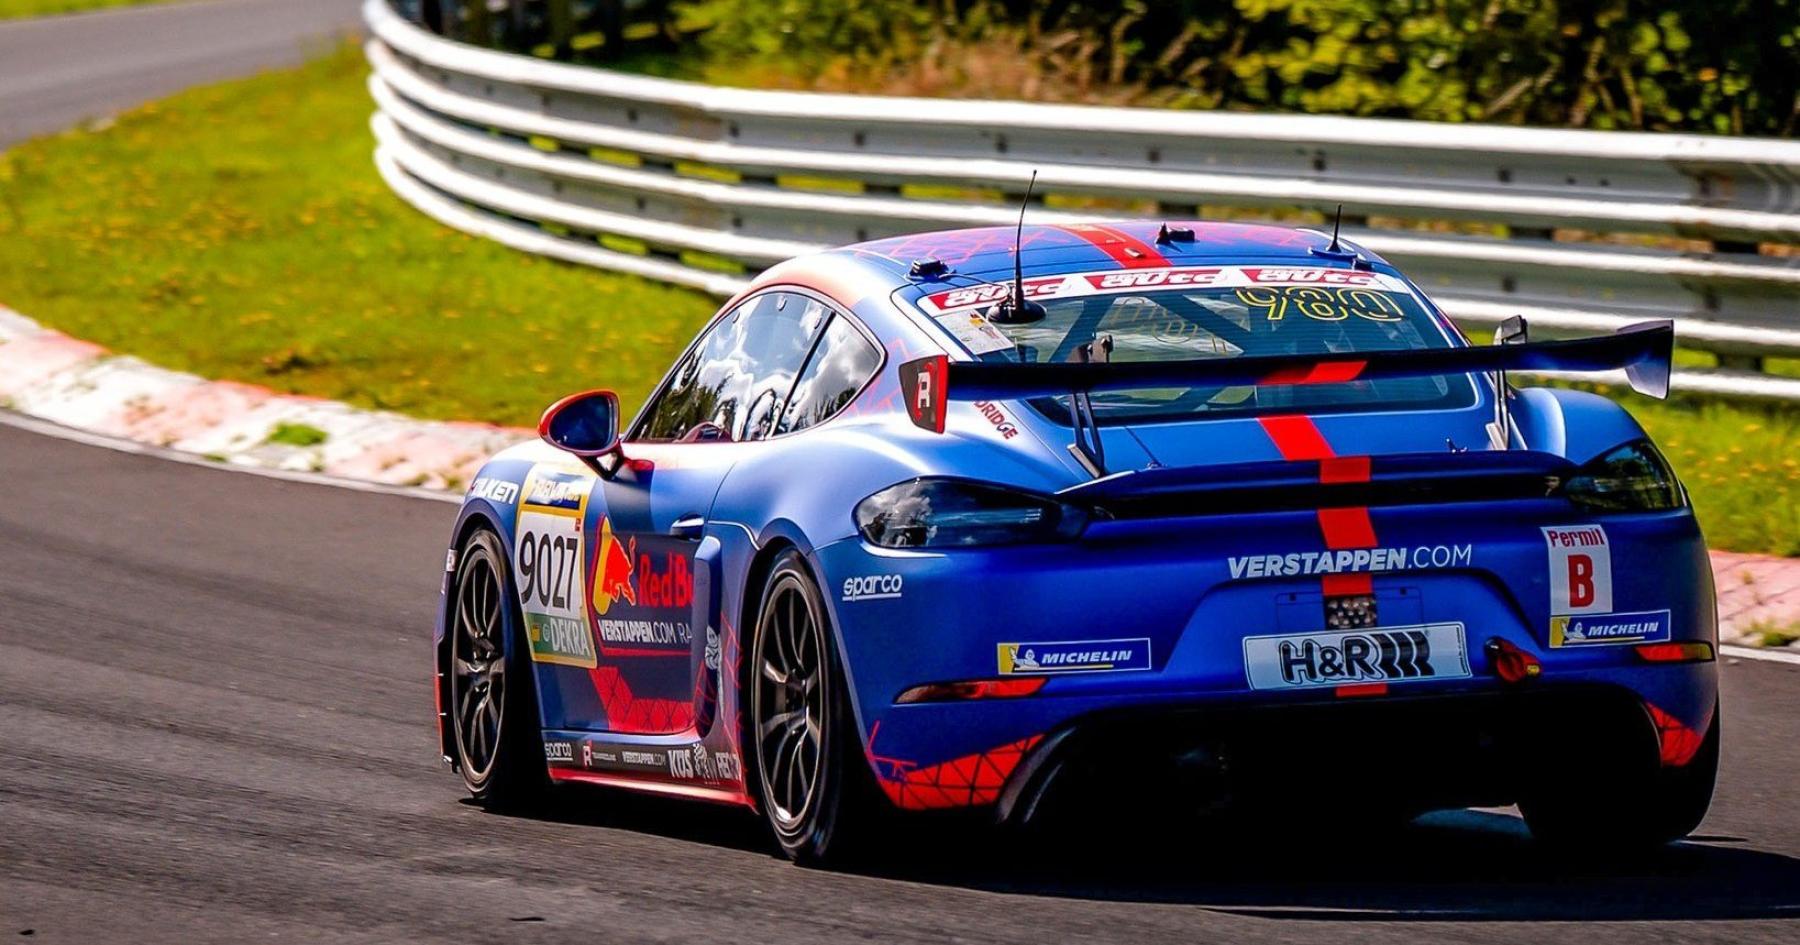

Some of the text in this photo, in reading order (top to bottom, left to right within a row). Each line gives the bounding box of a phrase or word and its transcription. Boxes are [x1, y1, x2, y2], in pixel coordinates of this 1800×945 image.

[1235, 286, 1404, 321] 980
[518, 530, 579, 612] 9027
[1227, 543, 1473, 579] VERSTAPPEN.COM
[637, 551, 673, 607] Red
[842, 573, 903, 601] sparco
[1567, 553, 1595, 608] B
[549, 616, 592, 657] DEKRA
[598, 618, 677, 645] VERSTAPPEN.COM
[1588, 621, 1659, 636] MICHELIN
[1041, 650, 1132, 664] MICHELIN
[544, 742, 574, 761] sparco
[621, 751, 666, 766] VERSTAPPEN.COM
